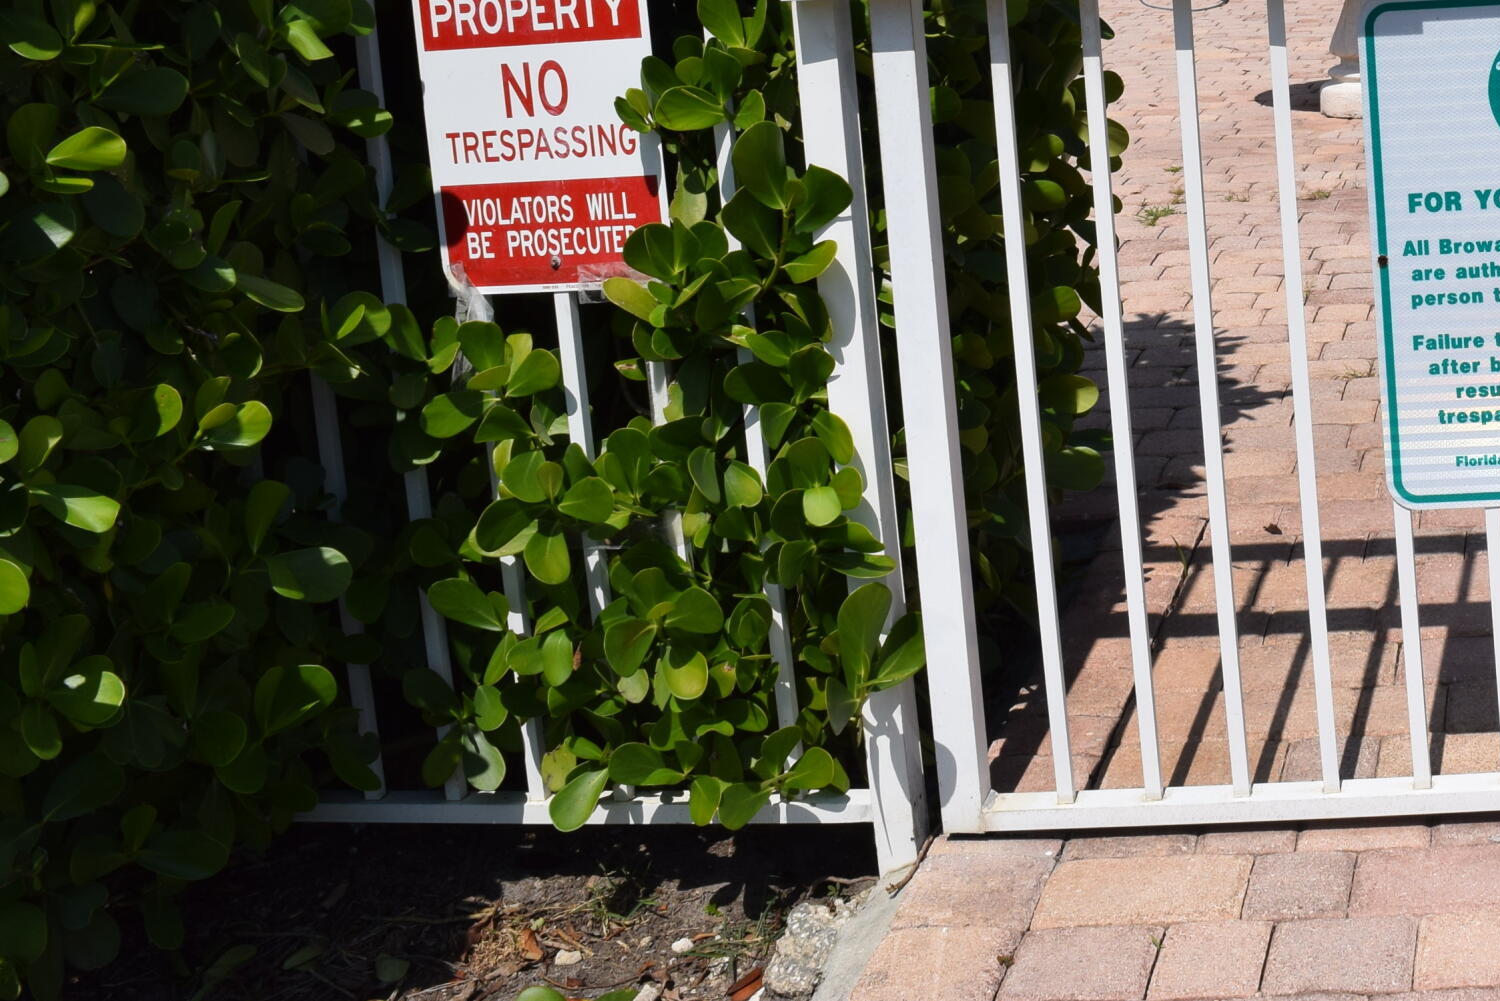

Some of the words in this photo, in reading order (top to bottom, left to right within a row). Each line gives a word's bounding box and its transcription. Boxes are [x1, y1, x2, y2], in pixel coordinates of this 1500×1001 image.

[501, 61, 568, 117] NO
[446, 125, 636, 162] TRESPASSING
[463, 195, 573, 226] VIOLATORS
[586, 192, 636, 220] WILL
[1408, 191, 1462, 213] FOR
[467, 232, 495, 259] BE
[1403, 240, 1429, 256] All
[1412, 268, 1445, 281] are
[1412, 292, 1483, 309] person
[1413, 334, 1484, 351] Failure
[1429, 359, 1480, 375] after
